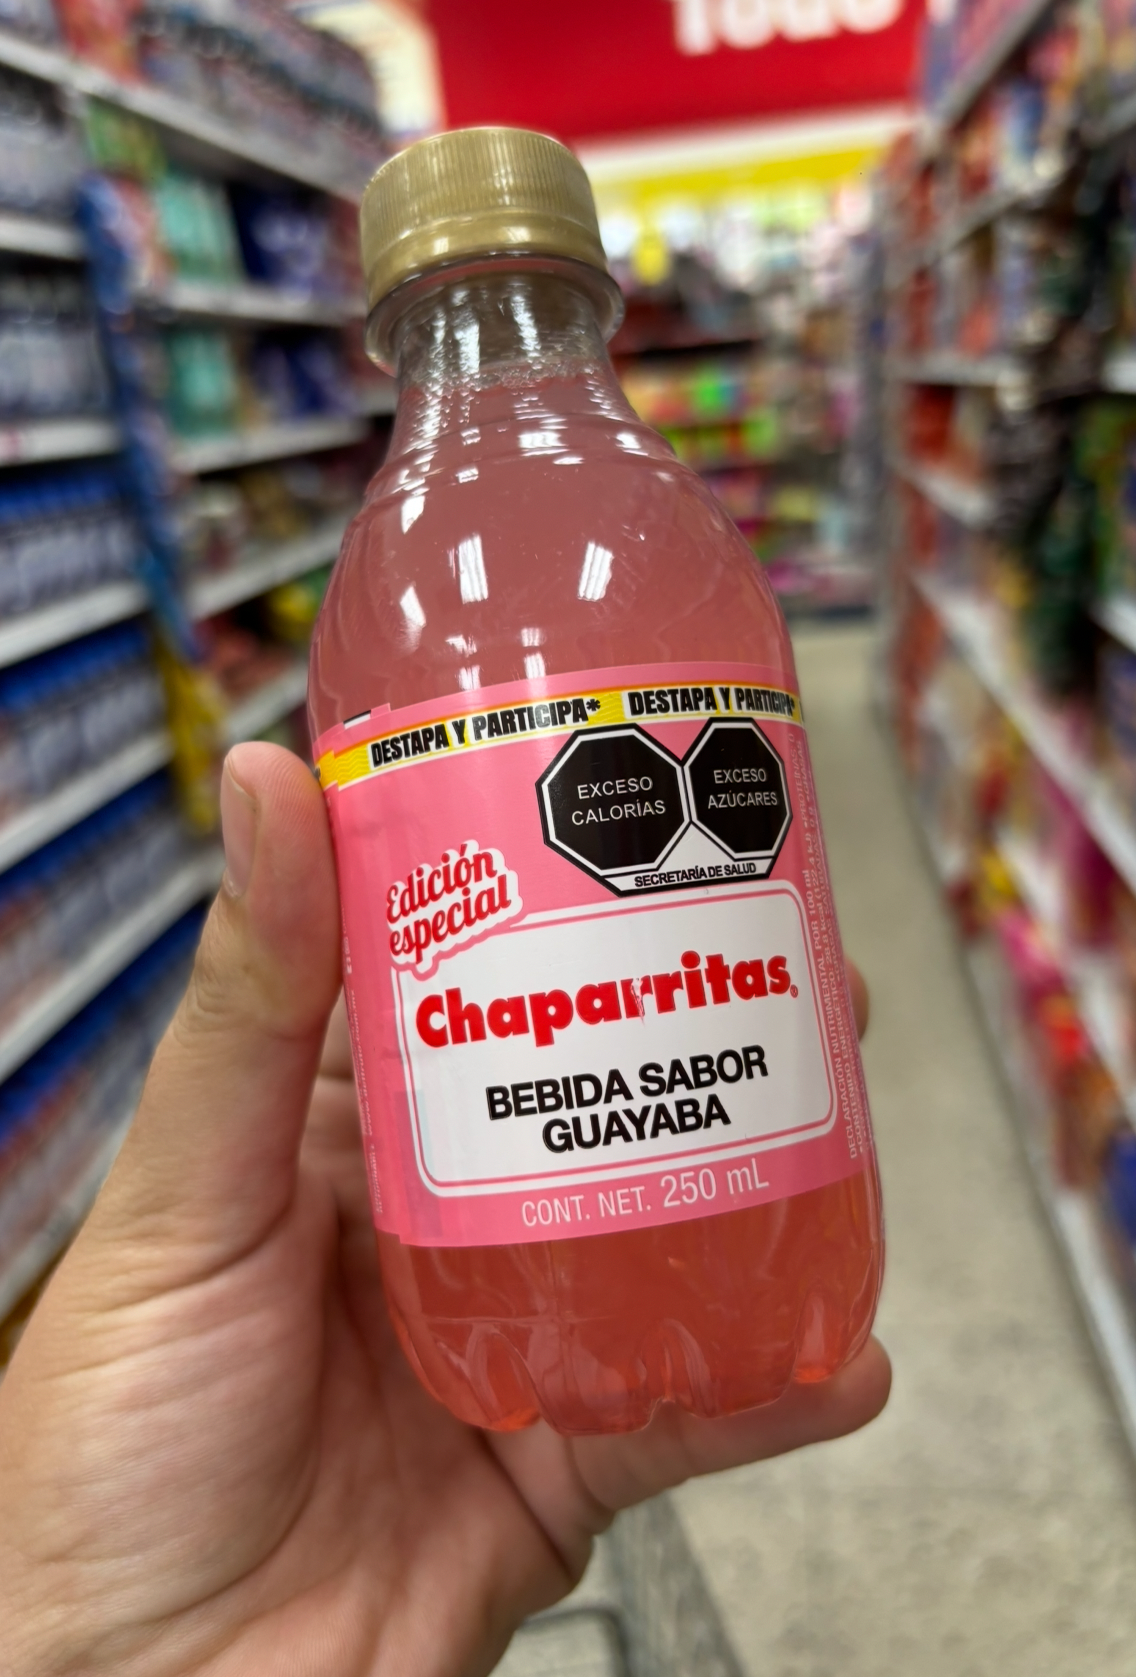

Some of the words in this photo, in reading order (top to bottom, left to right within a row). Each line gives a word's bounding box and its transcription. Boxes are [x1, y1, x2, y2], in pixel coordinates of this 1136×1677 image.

[628, 687, 718, 716] DESTAPA
[721, 687, 731, 710] Y
[371, 723, 450, 768] DESTAPA
[452, 719, 466, 744] Y
[577, 776, 653, 799] EXCESO
[713, 768, 767, 784] EXCESO
[571, 800, 666, 825] CALORÍAS
[707, 790, 778, 809] AZÚCARES
[387, 843, 498, 924] Edición
[634, 865, 707, 887] SECRETARÍA
[709, 866, 722, 877] DE
[724, 862, 756, 876] SALUD
[805, 889, 816, 916] 100
[816, 902, 826, 930] kcal
[390, 874, 511, 965] especial
[810, 919, 822, 950] POR
[816, 953, 839, 1053] NUTRIMENTAL
[486, 1069, 633, 1120] BEBIDA
[639, 1045, 768, 1096] SABOR
[833, 1057, 857, 1158] DECLARACIÓN
[542, 1094, 731, 1153] GUAYABA
[521, 1195, 590, 1227] CONT.
[598, 1186, 651, 1217] NET.
[660, 1168, 717, 1208] 250
[726, 1157, 769, 1195] mL
